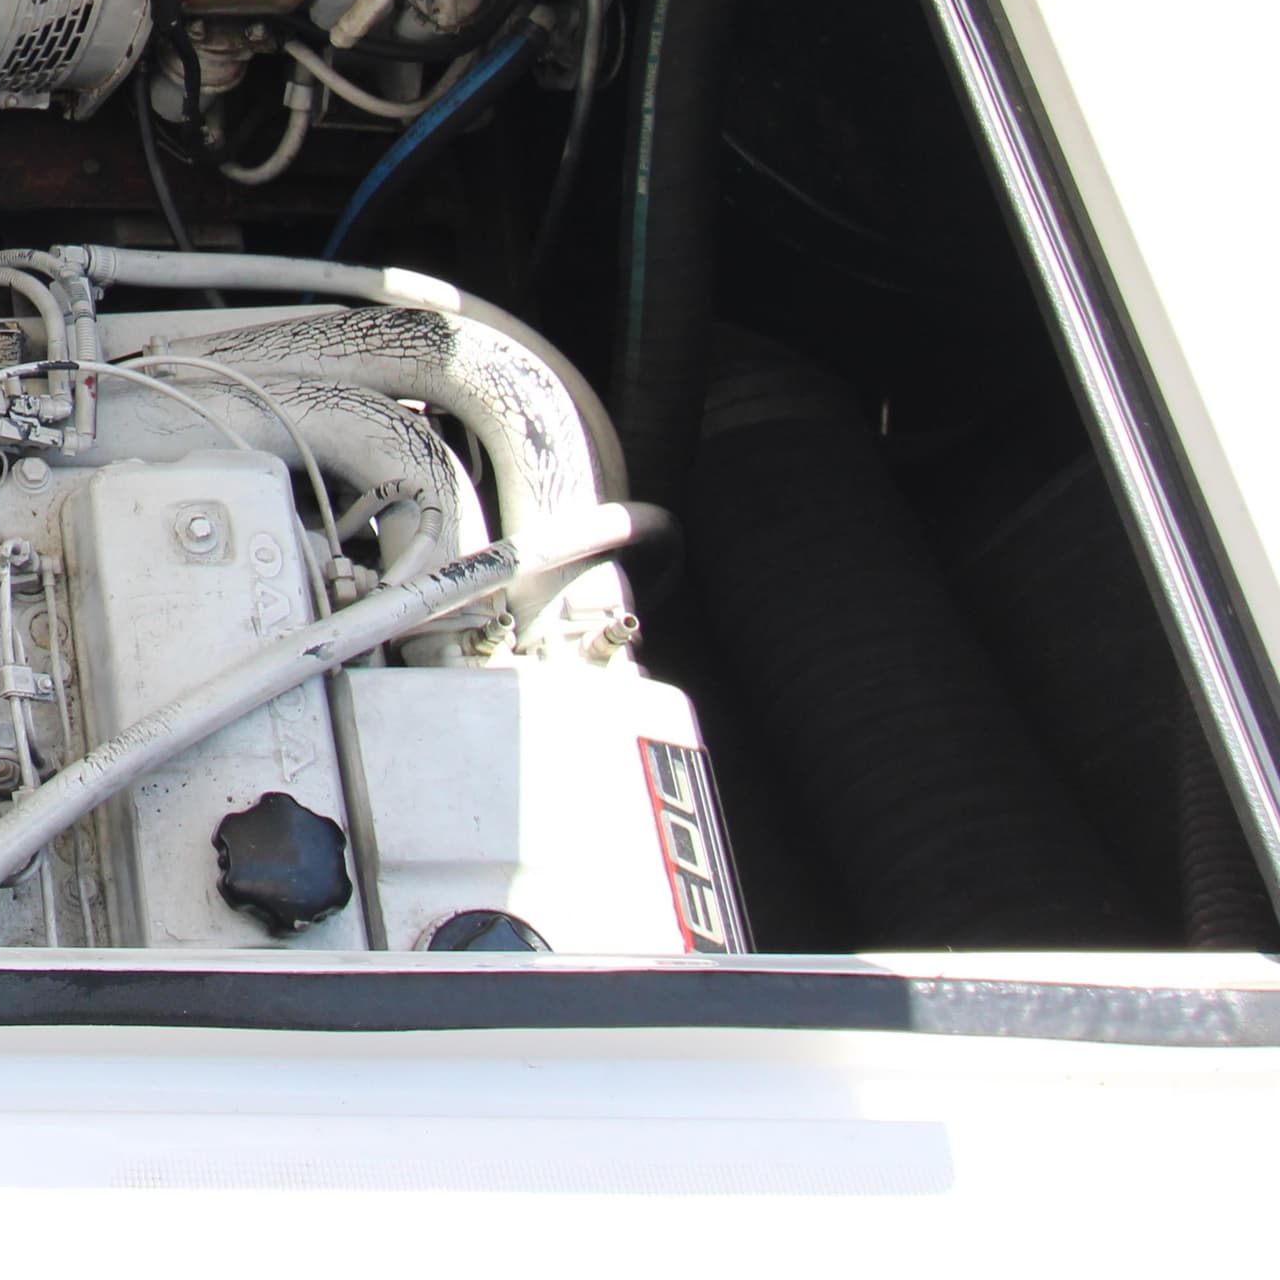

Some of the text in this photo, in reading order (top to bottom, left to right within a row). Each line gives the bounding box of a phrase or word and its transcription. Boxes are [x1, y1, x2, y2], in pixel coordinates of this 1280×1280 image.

[649, 32, 662, 57] WET
[642, 63, 658, 109] MARINE
[639, 115, 653, 171] PREMIUM
[248, 532, 315, 783] VOVO
[646, 745, 724, 946] EDC
